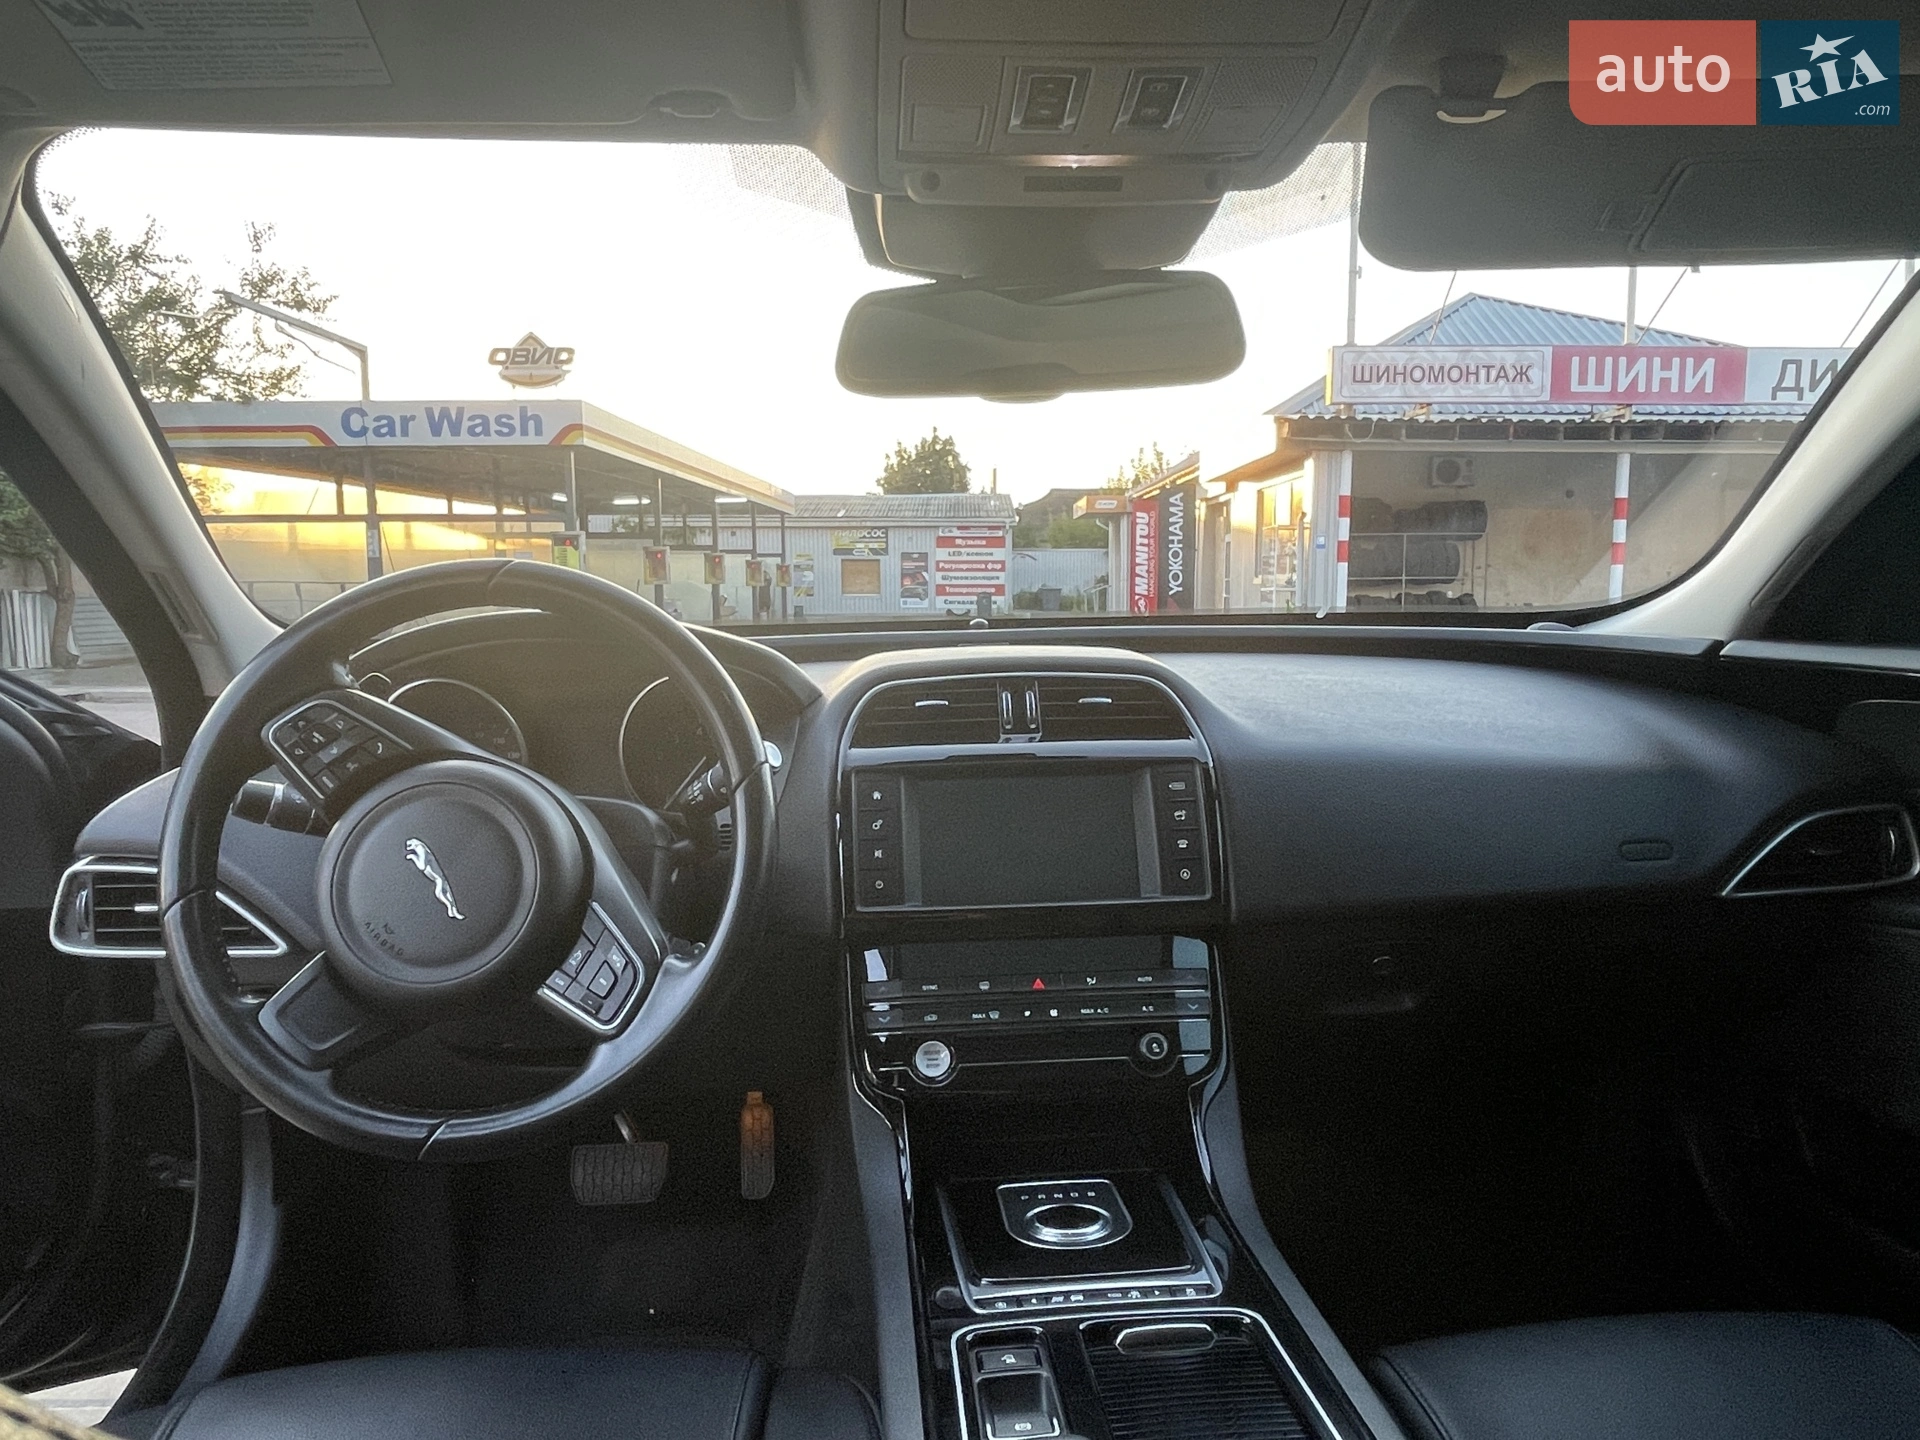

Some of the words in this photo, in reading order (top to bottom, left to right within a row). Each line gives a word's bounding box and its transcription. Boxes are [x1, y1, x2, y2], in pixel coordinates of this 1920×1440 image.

[1351, 362, 1534, 387] ШИНОМОНТАЖ
[1570, 355, 1716, 395] ШИНИ
[340, 406, 416, 439] Car
[424, 405, 544, 439] Wash
[1135, 511, 1149, 596] MANITOU
[1168, 492, 1184, 596] YOKOHAMA
[363, 920, 405, 957] AIRBAG
[1097, 1006, 1110, 1014] A/C
